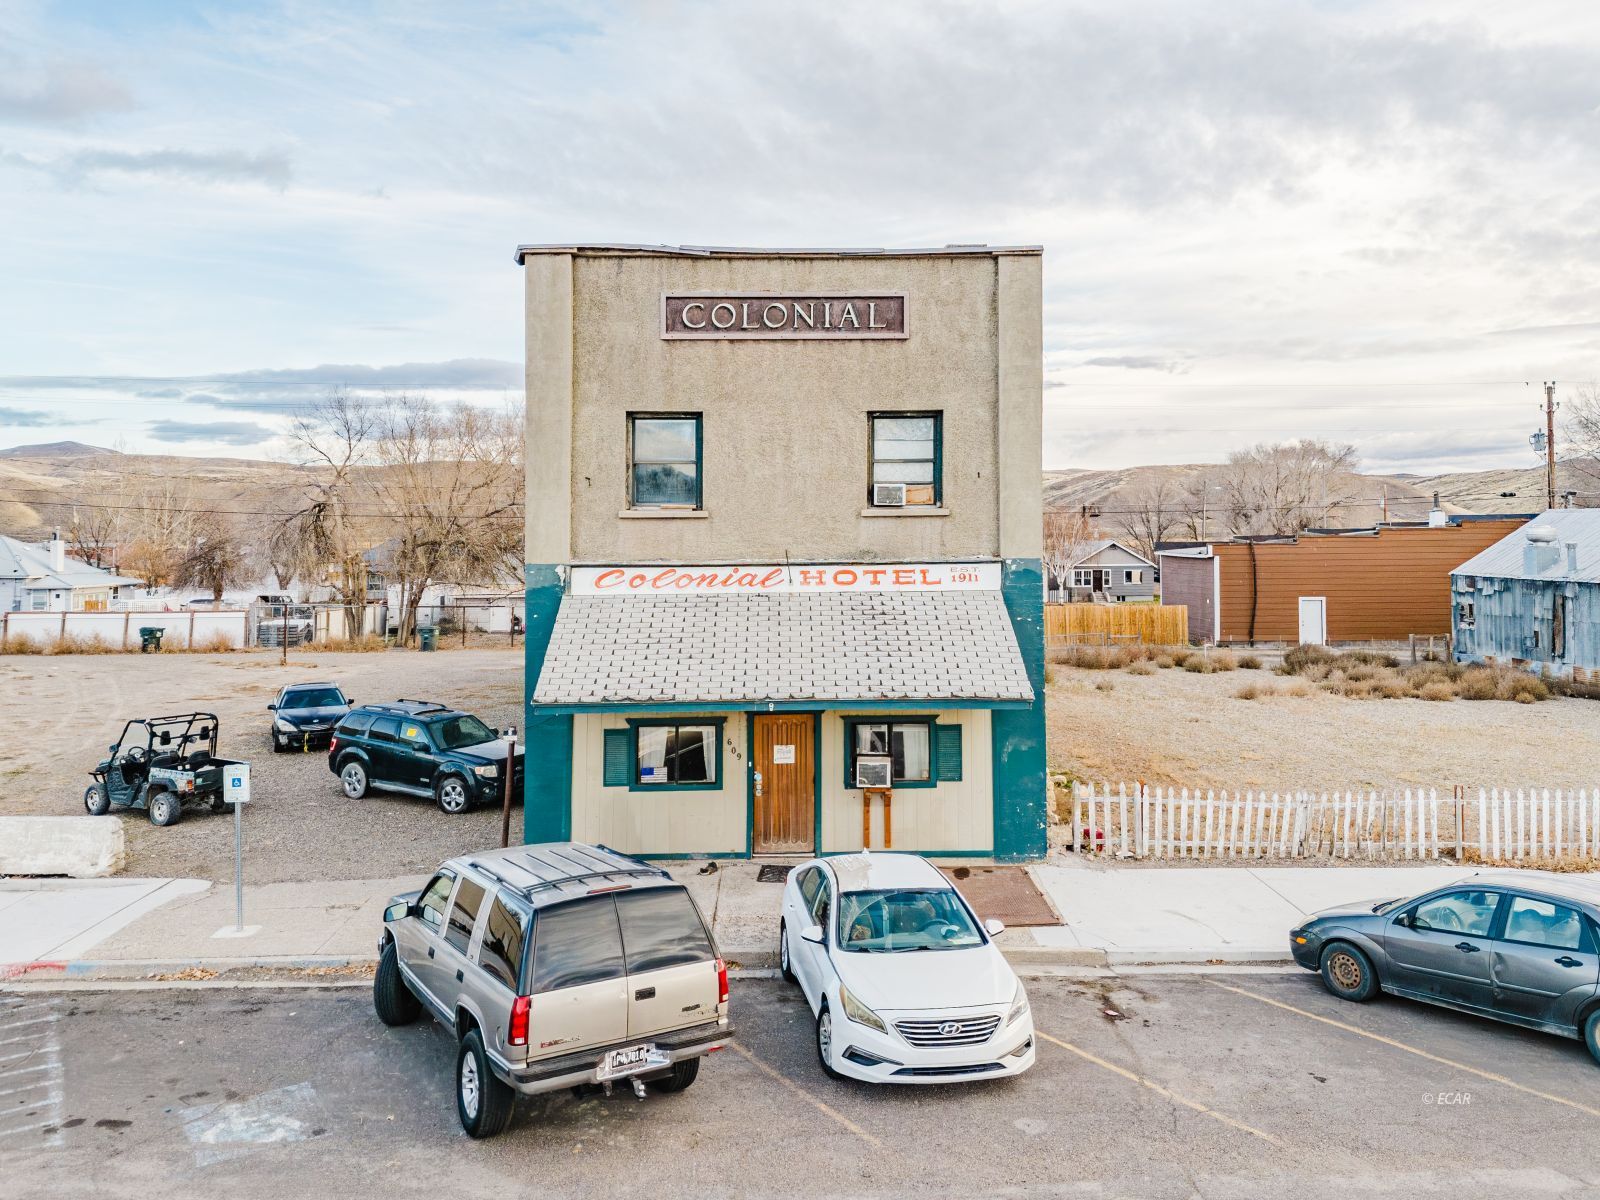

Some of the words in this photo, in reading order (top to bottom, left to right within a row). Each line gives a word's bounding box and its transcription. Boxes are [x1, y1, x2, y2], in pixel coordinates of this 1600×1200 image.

[682, 302, 887, 329] COLONIAL
[594, 567, 784, 589] Colonial
[800, 569, 942, 586] HOTEL
[951, 573, 979, 583] 1911
